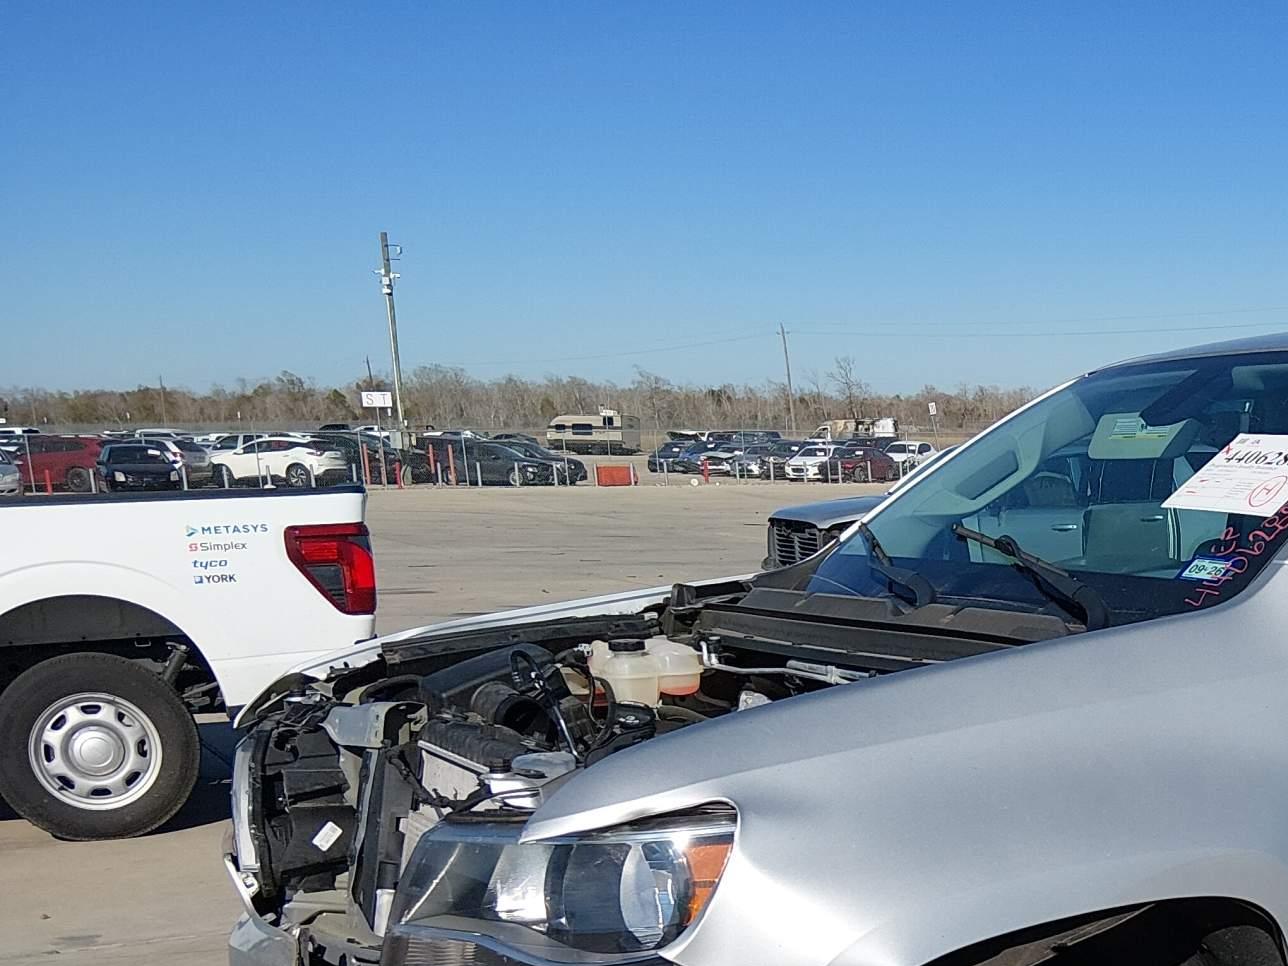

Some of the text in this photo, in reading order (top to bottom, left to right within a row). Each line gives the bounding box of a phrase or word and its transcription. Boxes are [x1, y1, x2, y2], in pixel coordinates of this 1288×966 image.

[201, 523, 269, 535] METASYS
[200, 541, 248, 552] Simplex
[192, 559, 228, 570] tyco
[1188, 564, 1204, 574] 09
[204, 573, 237, 584] YORK
